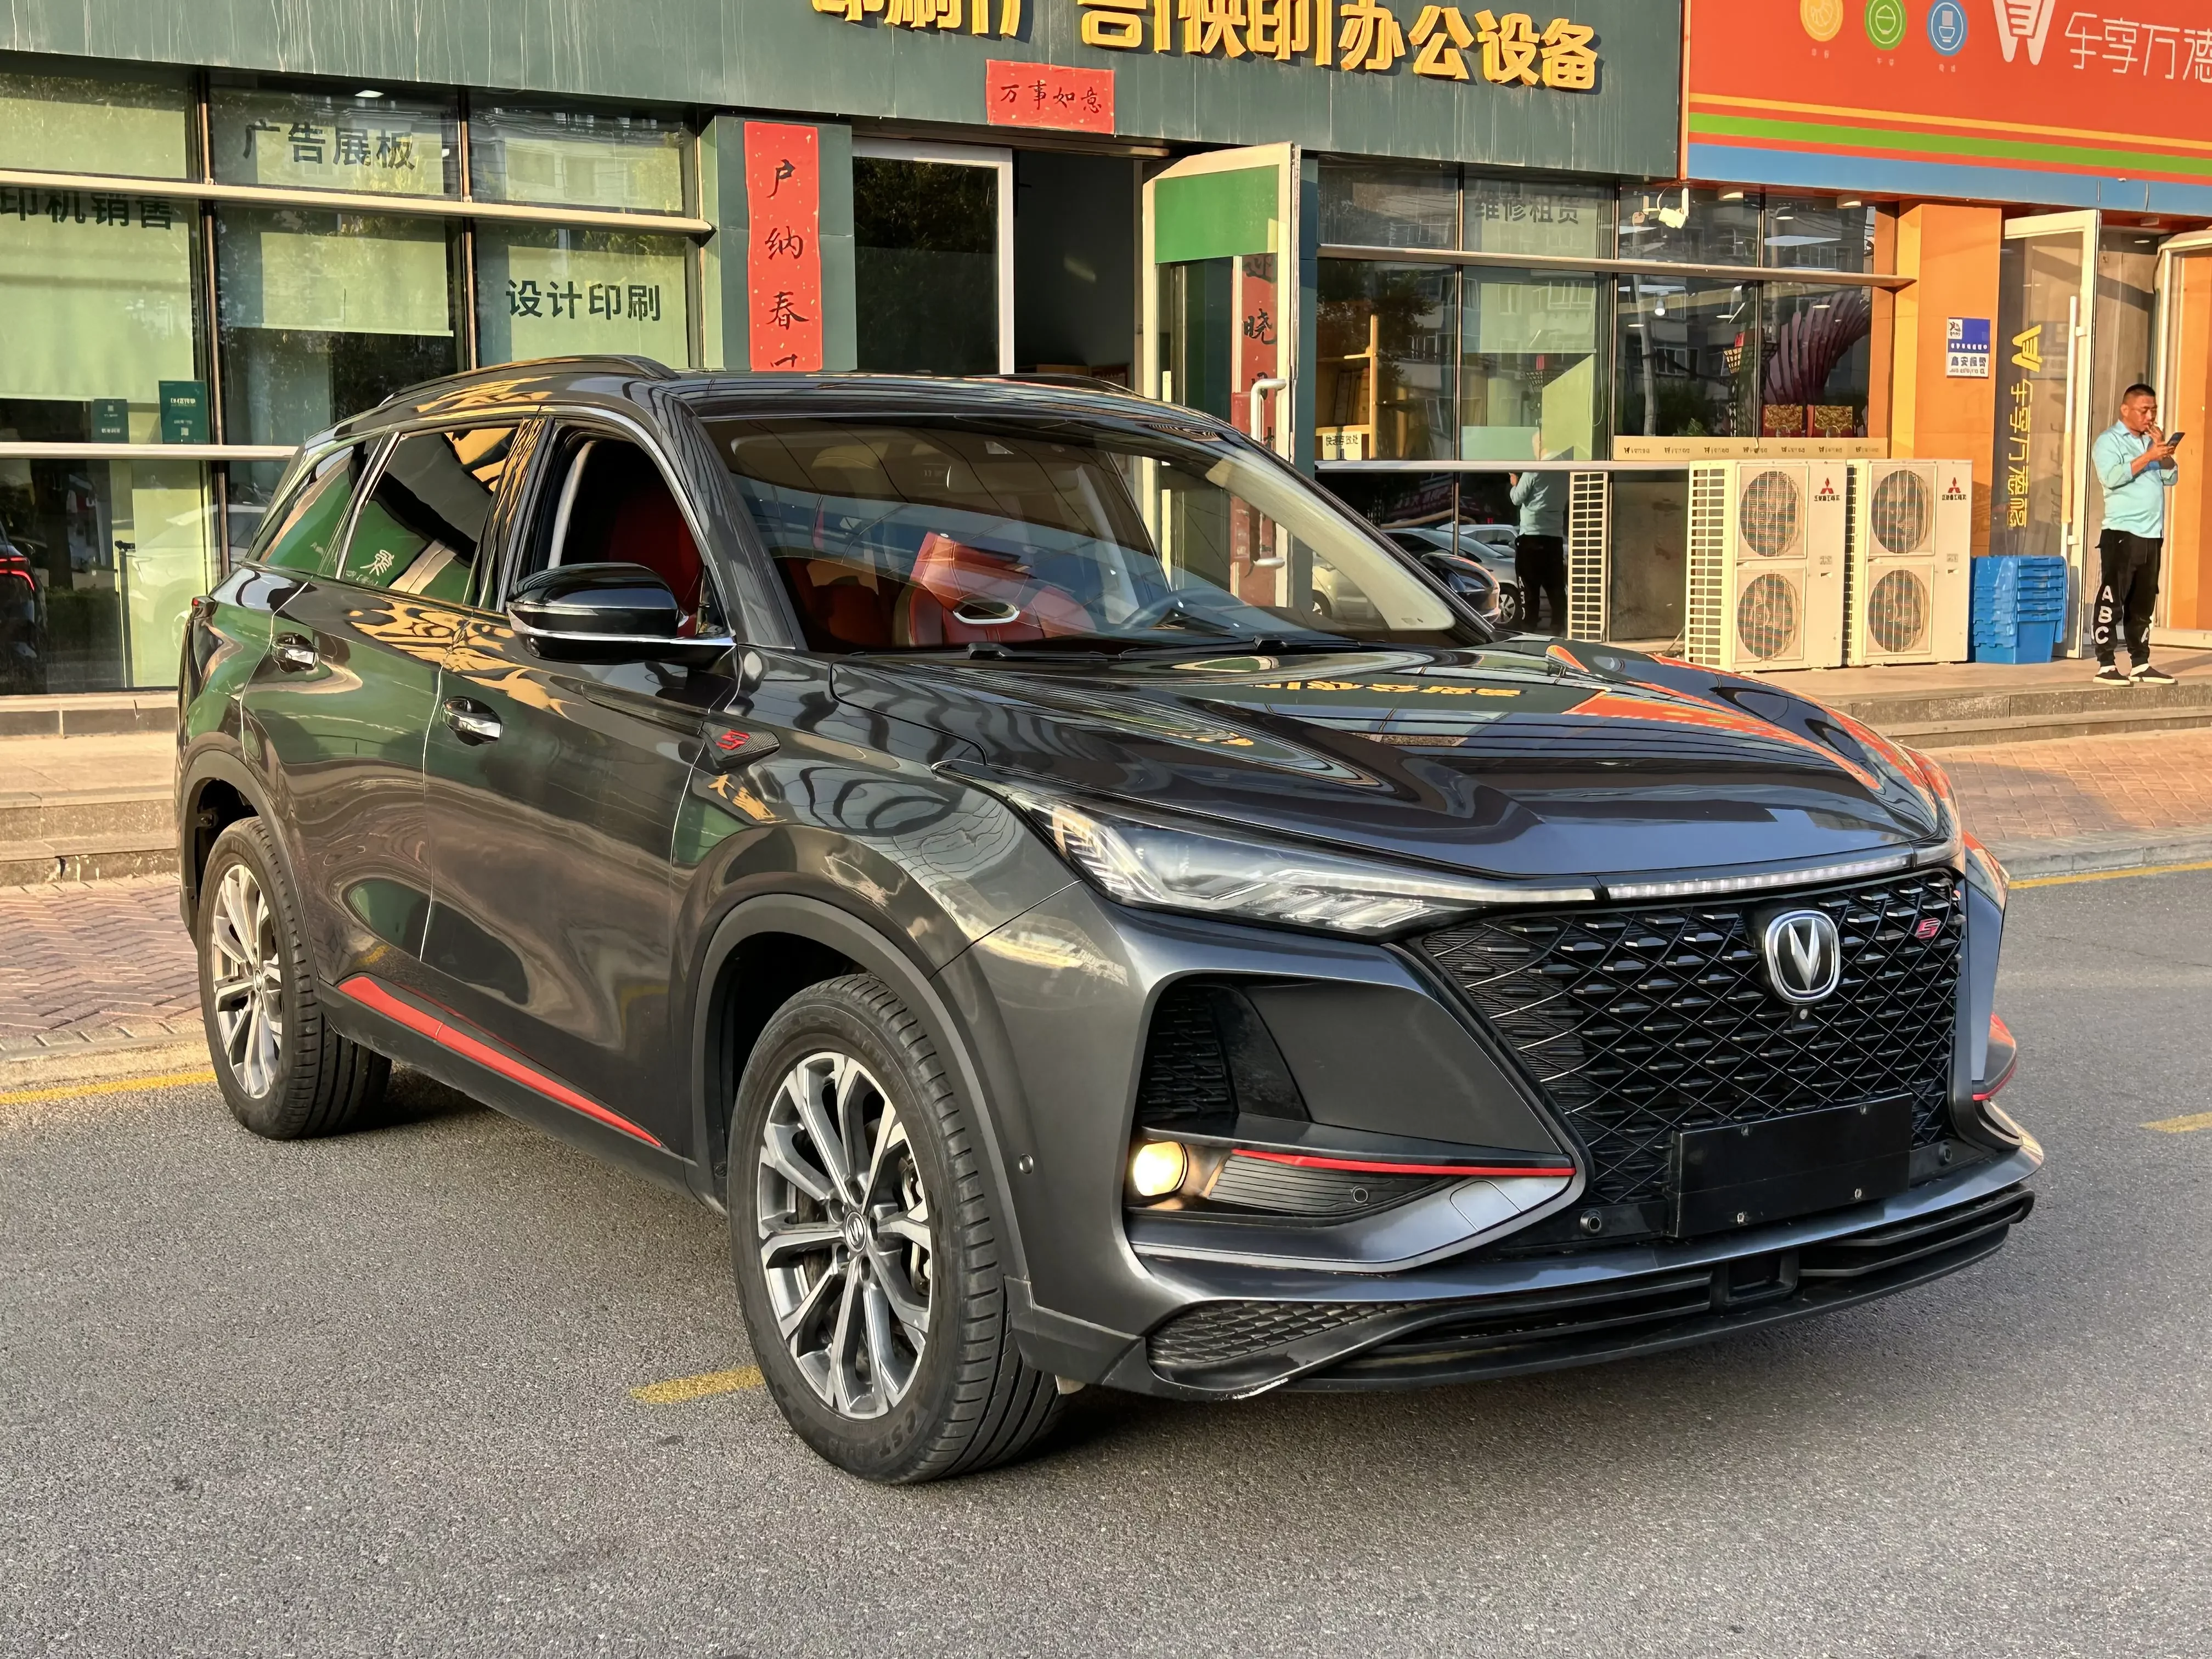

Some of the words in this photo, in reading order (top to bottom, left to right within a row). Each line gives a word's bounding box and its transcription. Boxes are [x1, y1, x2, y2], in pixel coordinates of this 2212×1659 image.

[1000, 80, 1102, 114] 万事如意
[242, 119, 415, 170] 广告展板
[0, 187, 172, 230] 印机销售
[1474, 190, 1579, 225] 维修租赁
[766, 159, 810, 368] 户纳春
[505, 279, 661, 321] 设计印刷
